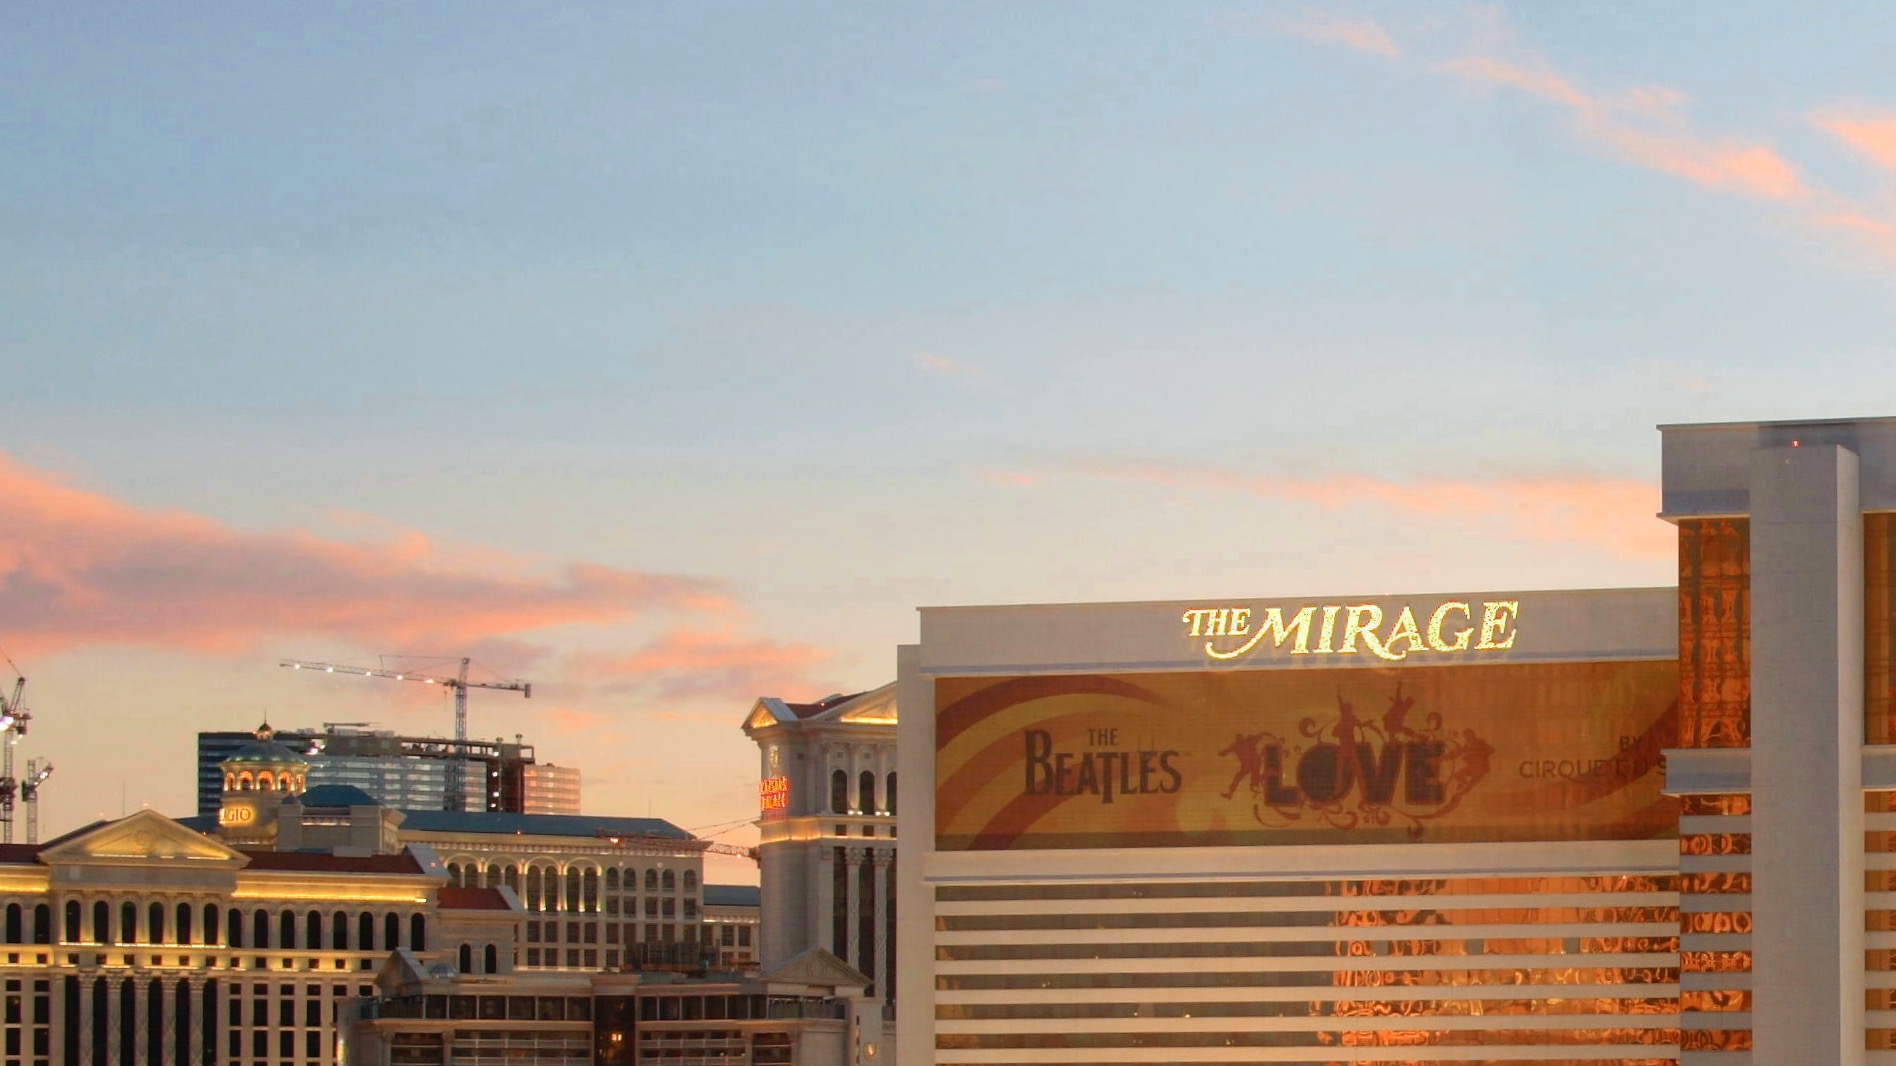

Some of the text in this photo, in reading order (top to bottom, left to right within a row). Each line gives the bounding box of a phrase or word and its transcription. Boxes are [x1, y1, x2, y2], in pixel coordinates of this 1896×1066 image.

[1183, 600, 1518, 660] THE MIRAGE
[1025, 729, 1182, 804] BEATLES
[1087, 728, 1119, 746] THE
[1263, 741, 1447, 807] LOVE
[1519, 759, 1605, 783] CIRQUE
